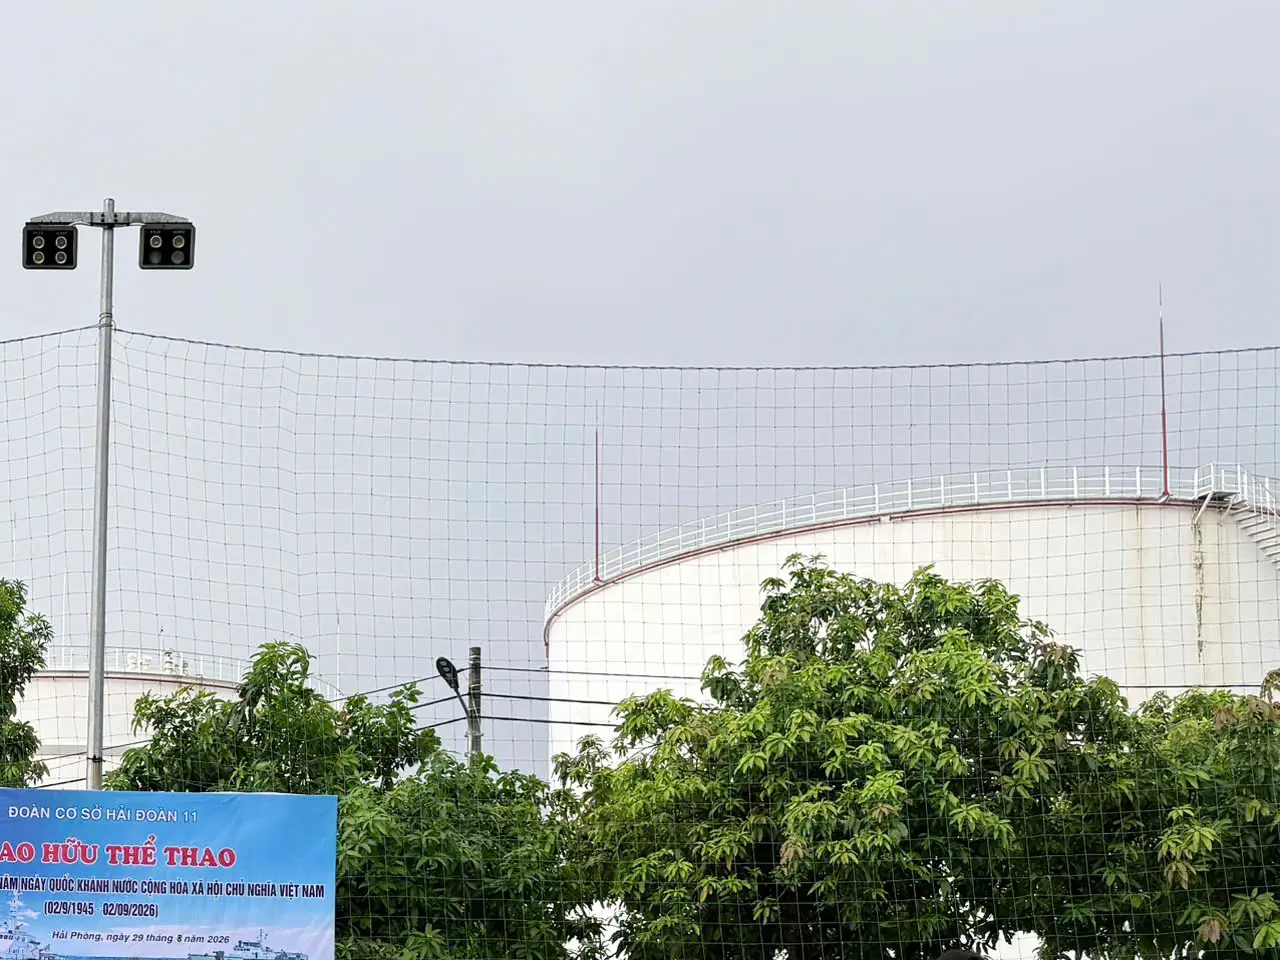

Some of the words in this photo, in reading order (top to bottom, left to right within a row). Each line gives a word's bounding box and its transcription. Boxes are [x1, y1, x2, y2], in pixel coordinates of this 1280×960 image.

[8, 804, 50, 819] ĐOÀN
[55, 806, 77, 820] CƠ
[81, 803, 102, 821] SỞ
[106, 804, 131, 822] HẢI
[135, 806, 178, 823] ĐOÀN
[183, 811, 198, 823] 11
[41, 837, 99, 865] HỮU
[105, 833, 157, 866] THỂ
[163, 846, 237, 868] THAO
[21, 874, 46, 891] NGÀY
[49, 873, 74, 893] QUỐC
[77, 876, 109, 893] KHÁNH
[112, 877, 138, 893] NƯỚC
[141, 878, 167, 896] CỘNG
[169, 878, 189, 895] HÒA
[191, 879, 204, 895] XÃ
[207, 880, 223, 898] HỘI
[225, 879, 245, 896] CHỦ
[247, 881, 277, 897] NGHĨA
[280, 882, 299, 900] VIỆT
[302, 884, 325, 898] NAM
[44, 901, 94, 915] (02/9/1945
[103, 902, 158, 918] 02/09/2026)
[52, 930, 68, 939] Hải
[70, 931, 103, 942] Phòng,
[106, 932, 130, 943] ngày
[132, 933, 144, 942] 29
[146, 933, 173, 944] tháng
[184, 935, 204, 943] năm
[207, 935, 230, 944] 2026
